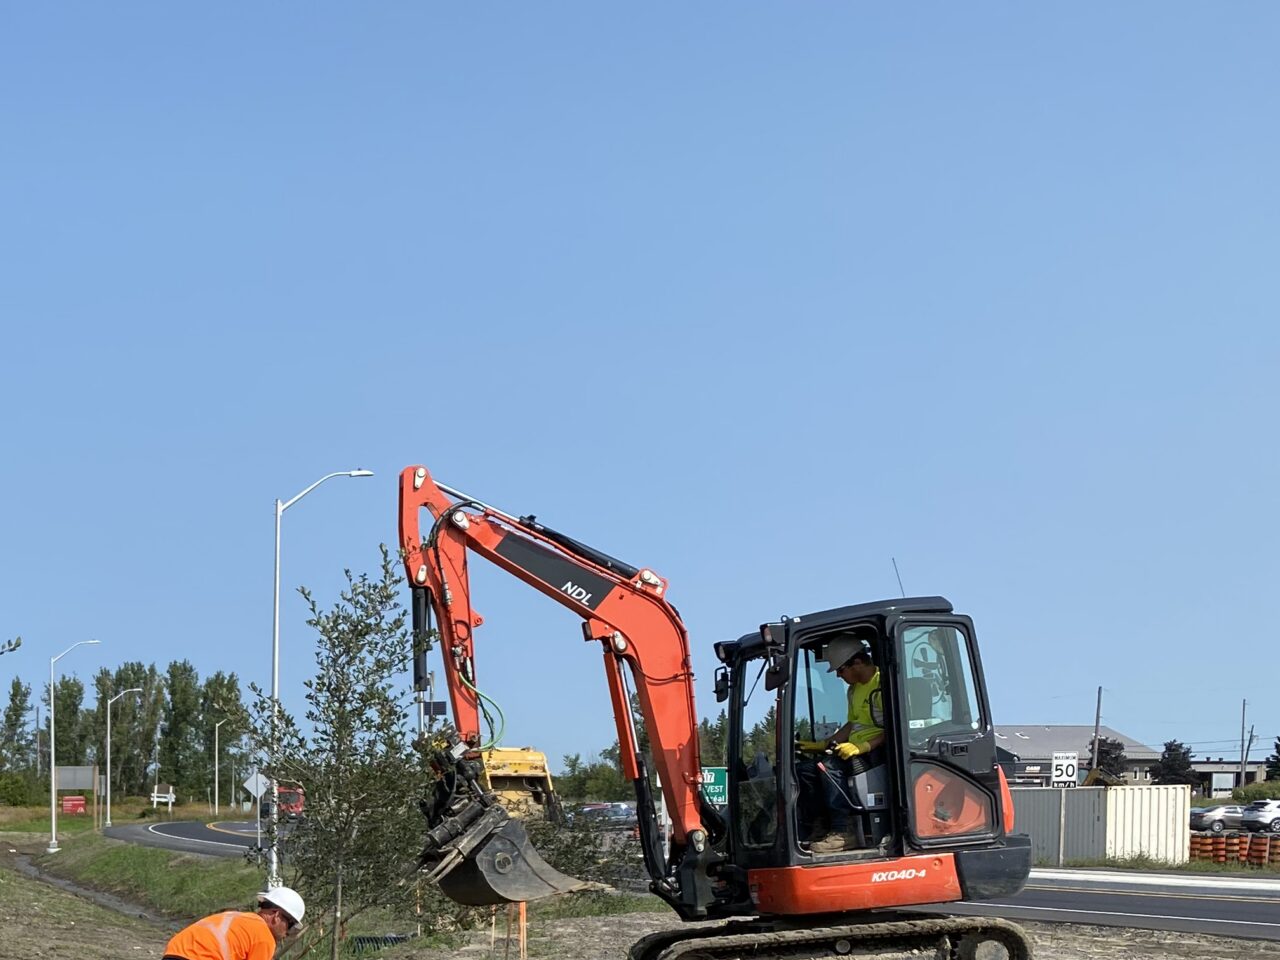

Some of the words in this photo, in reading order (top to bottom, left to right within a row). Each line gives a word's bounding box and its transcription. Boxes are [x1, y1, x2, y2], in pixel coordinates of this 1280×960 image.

[561, 580, 593, 606] NDL
[1054, 763, 1076, 778] 50
[871, 868, 927, 883] KX040-4
